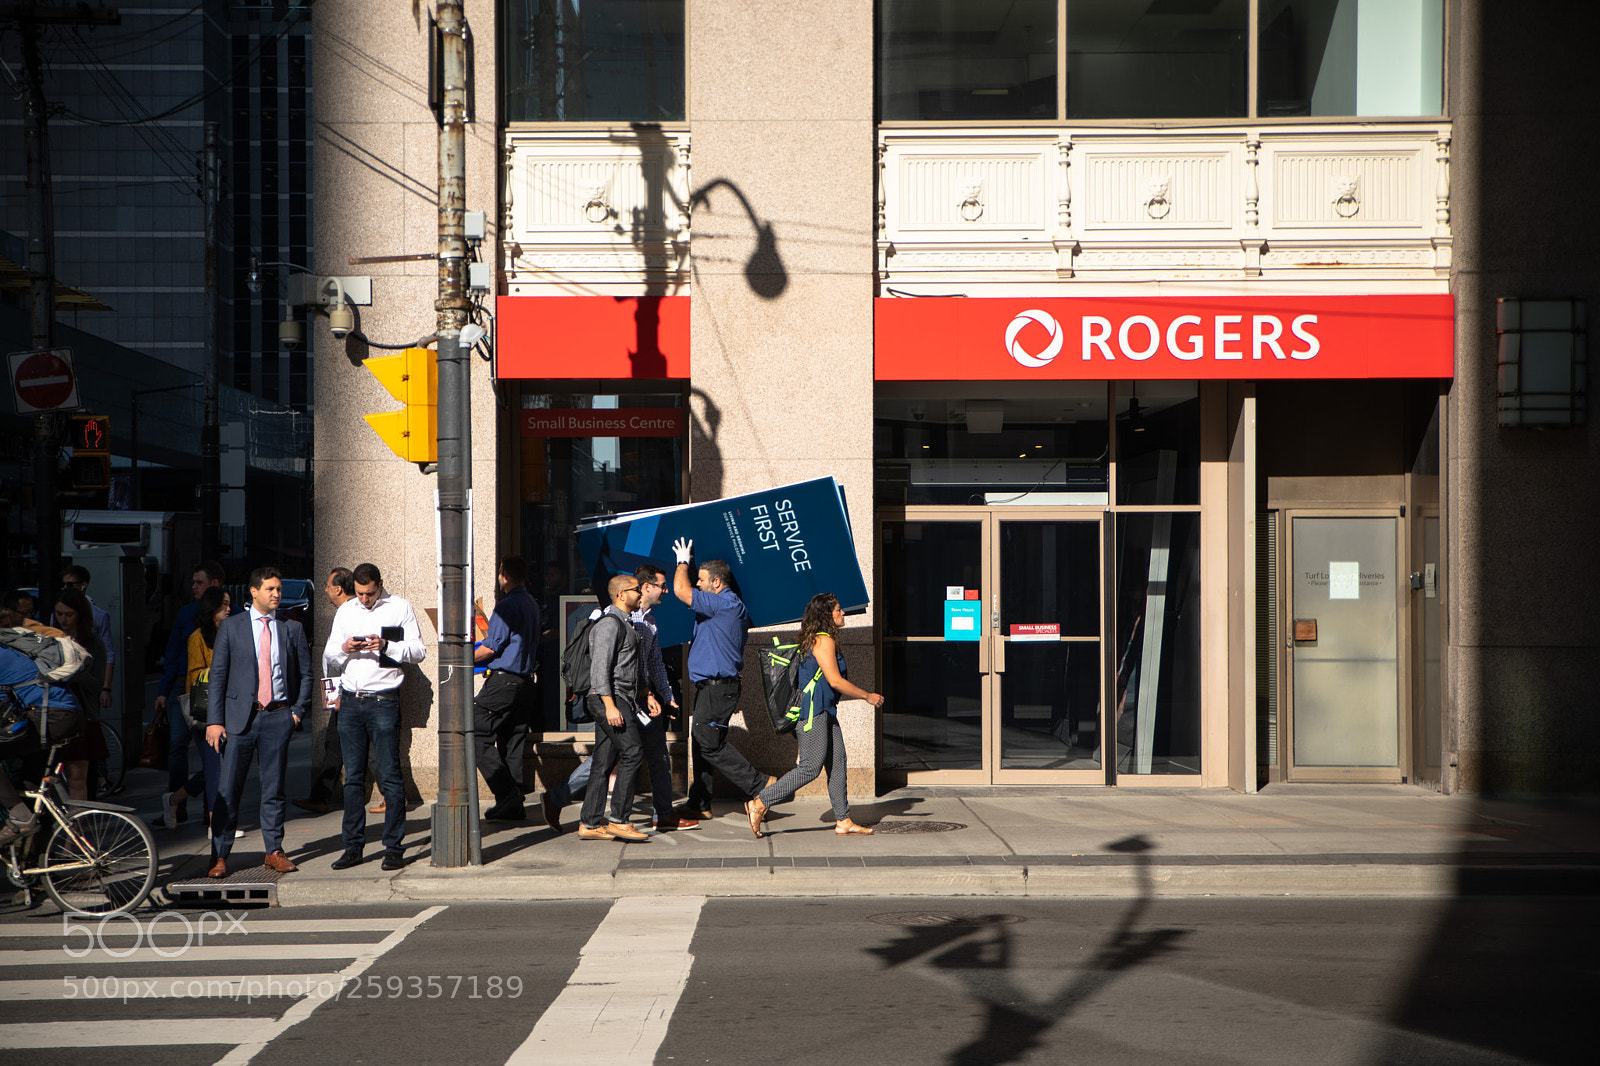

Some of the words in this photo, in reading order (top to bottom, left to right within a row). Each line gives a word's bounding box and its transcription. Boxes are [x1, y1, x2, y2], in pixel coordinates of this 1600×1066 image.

[1082, 314, 1321, 361] ROGERS
[528, 416, 565, 429] Small
[568, 416, 626, 429] Business
[629, 416, 675, 429] Centre
[726, 522, 734, 538] SERVICE
[732, 538, 743, 564] PHILOSOPHY
[750, 504, 780, 551] FIRST
[775, 499, 812, 572] SERVICE
[1305, 572, 1319, 580] Turf
[1359, 572, 1385, 580] liveries
